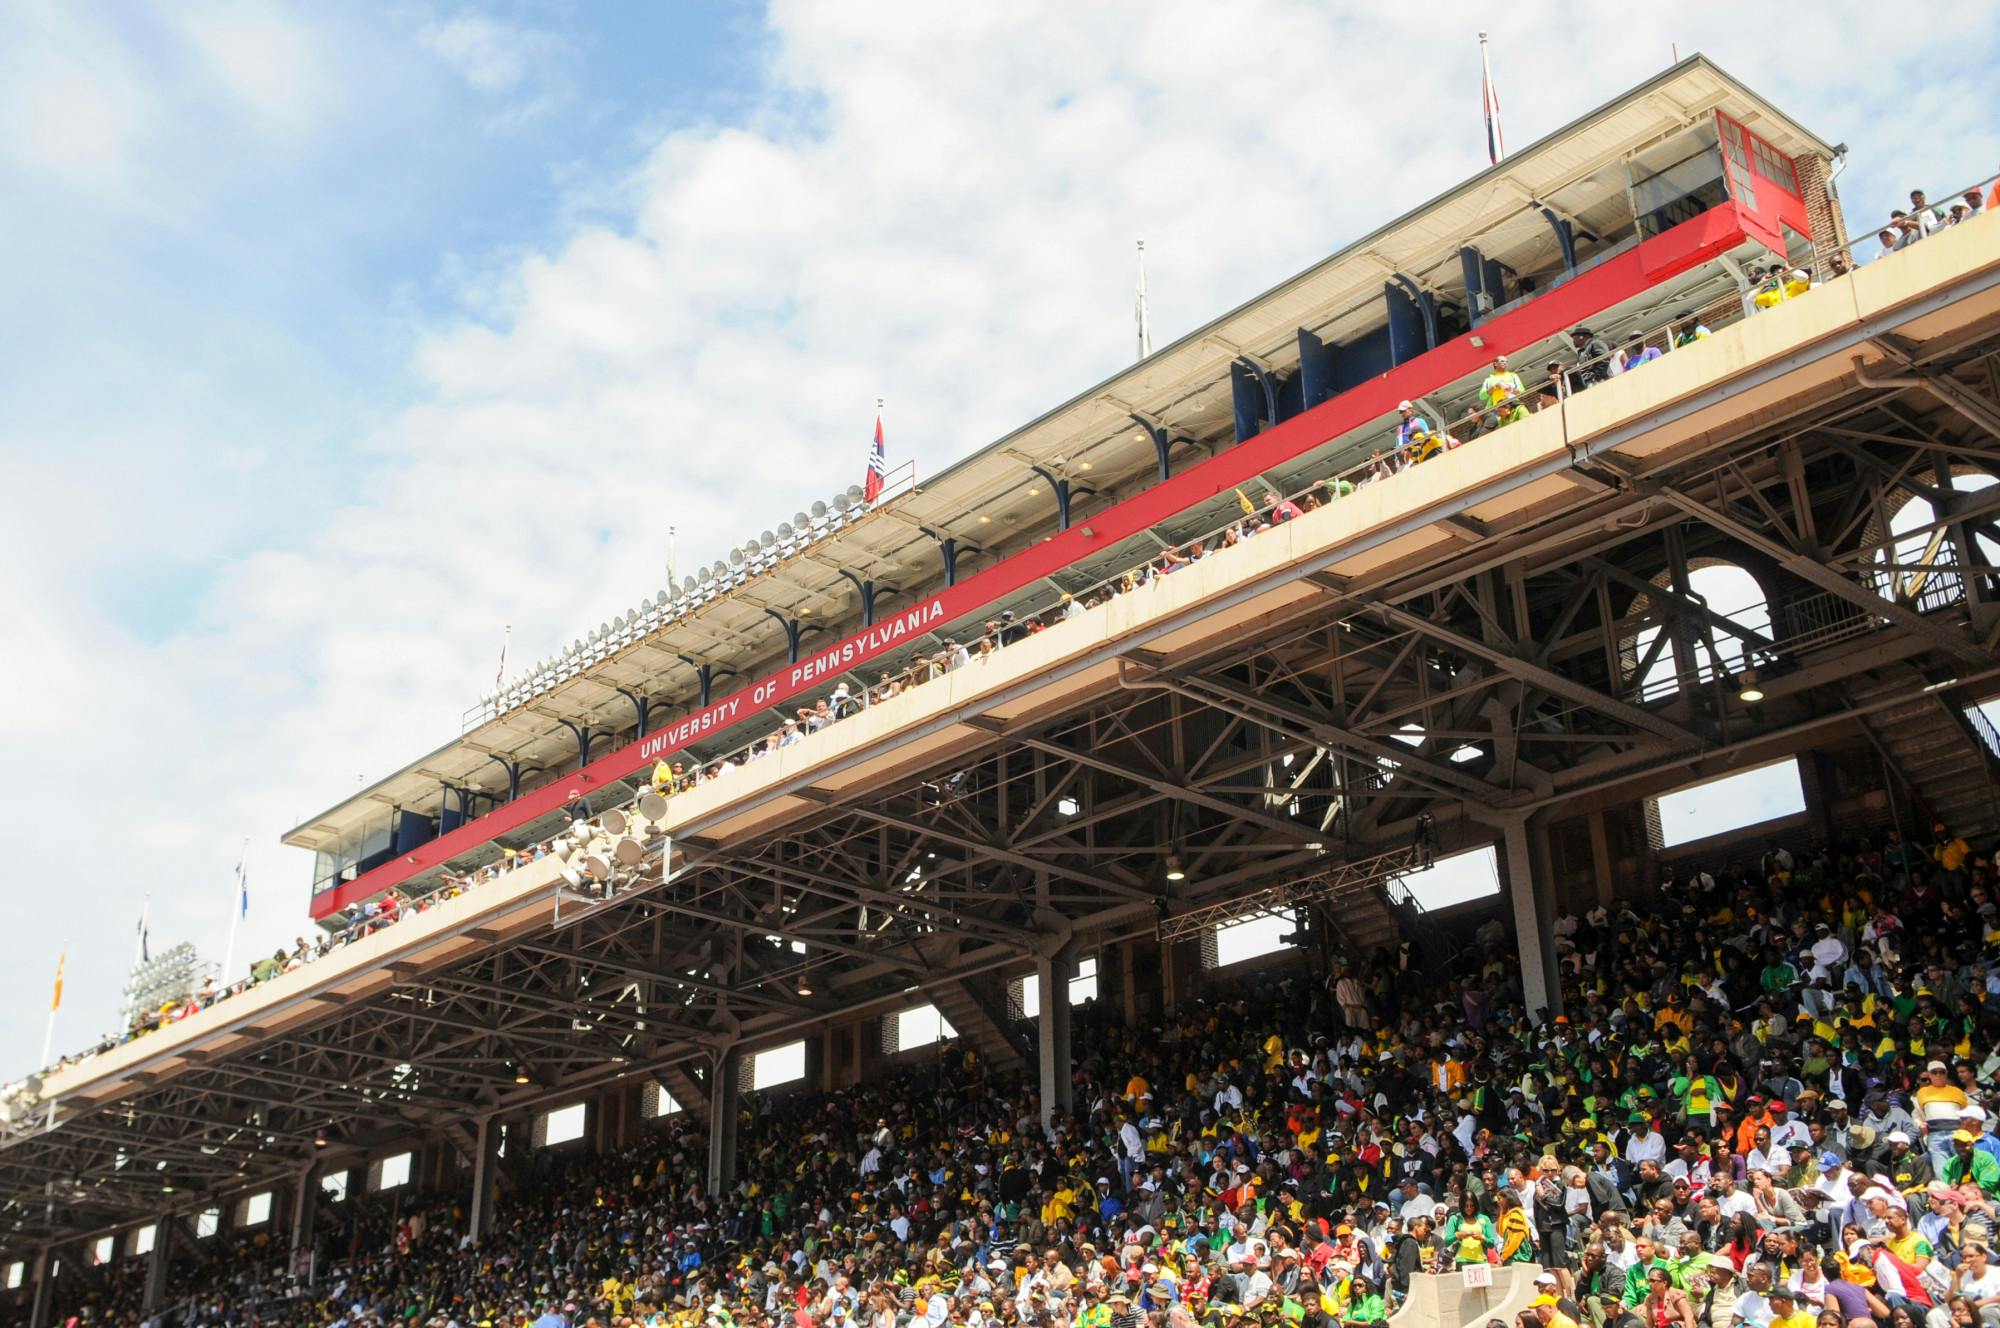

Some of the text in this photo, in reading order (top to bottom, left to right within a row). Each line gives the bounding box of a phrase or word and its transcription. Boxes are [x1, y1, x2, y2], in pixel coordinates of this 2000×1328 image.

[640, 599, 944, 759] UNIVERSITY OF PENNSYLVANIA
[1468, 1267, 1485, 1284] EXIT
